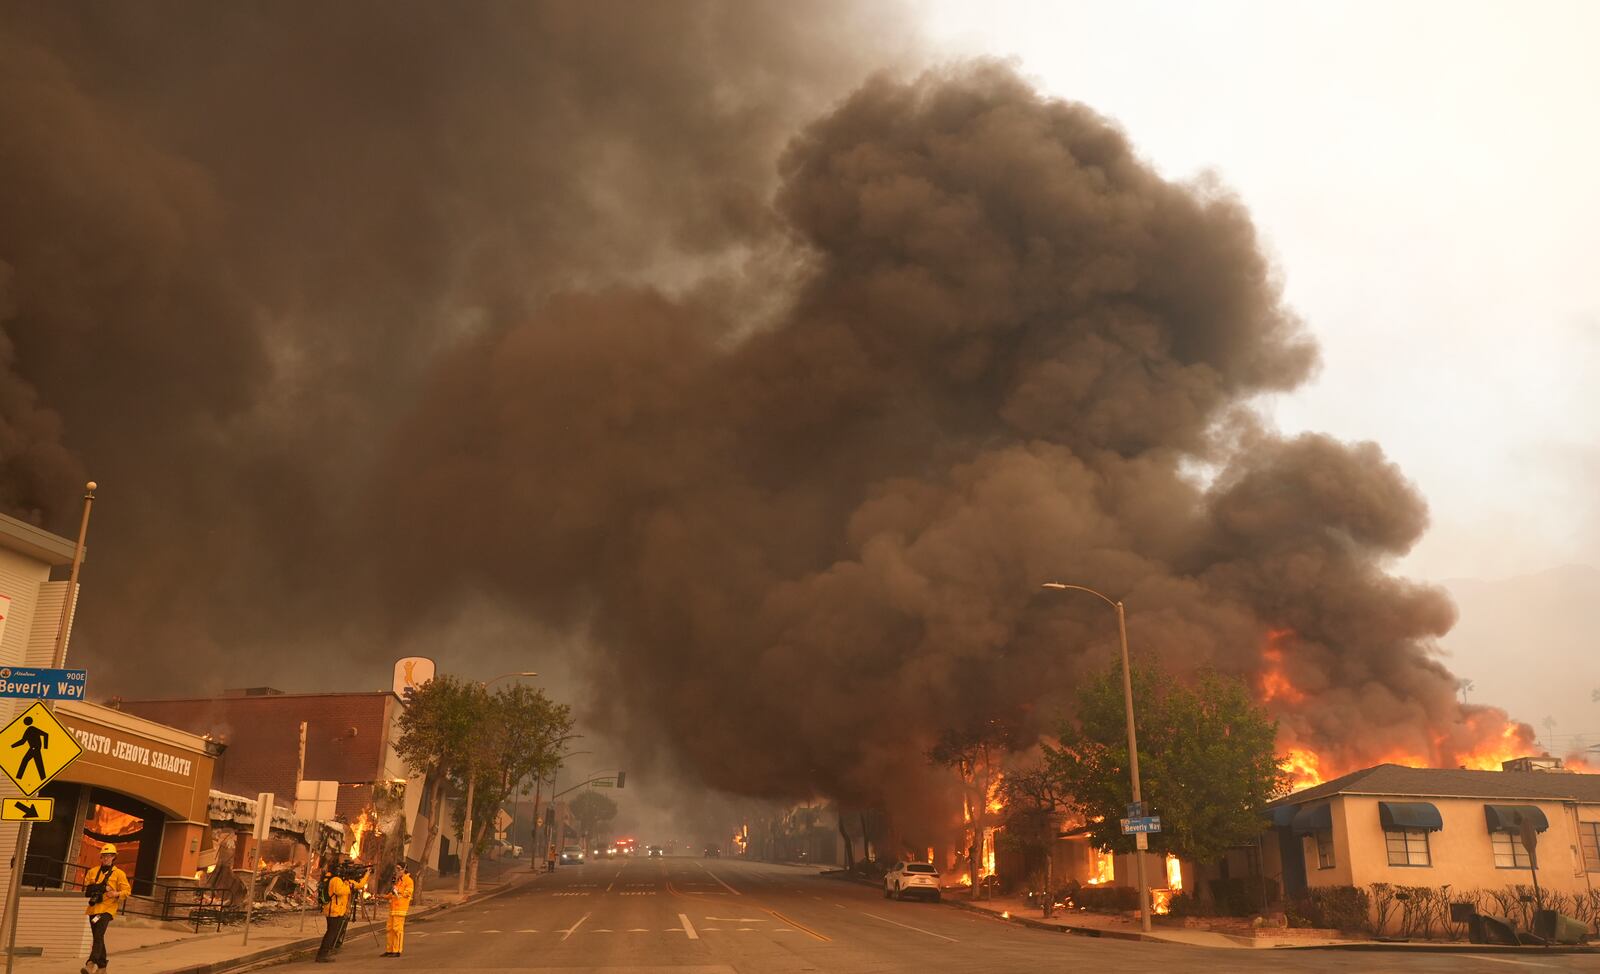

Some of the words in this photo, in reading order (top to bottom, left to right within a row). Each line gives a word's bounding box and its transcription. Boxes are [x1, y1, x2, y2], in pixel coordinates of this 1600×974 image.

[67, 672, 85, 680] 900E
[0, 680, 50, 697] Beverly
[57, 682, 83, 698] Way
[112, 741, 149, 766] JEHOVA
[151, 751, 191, 776] SABAOTH
